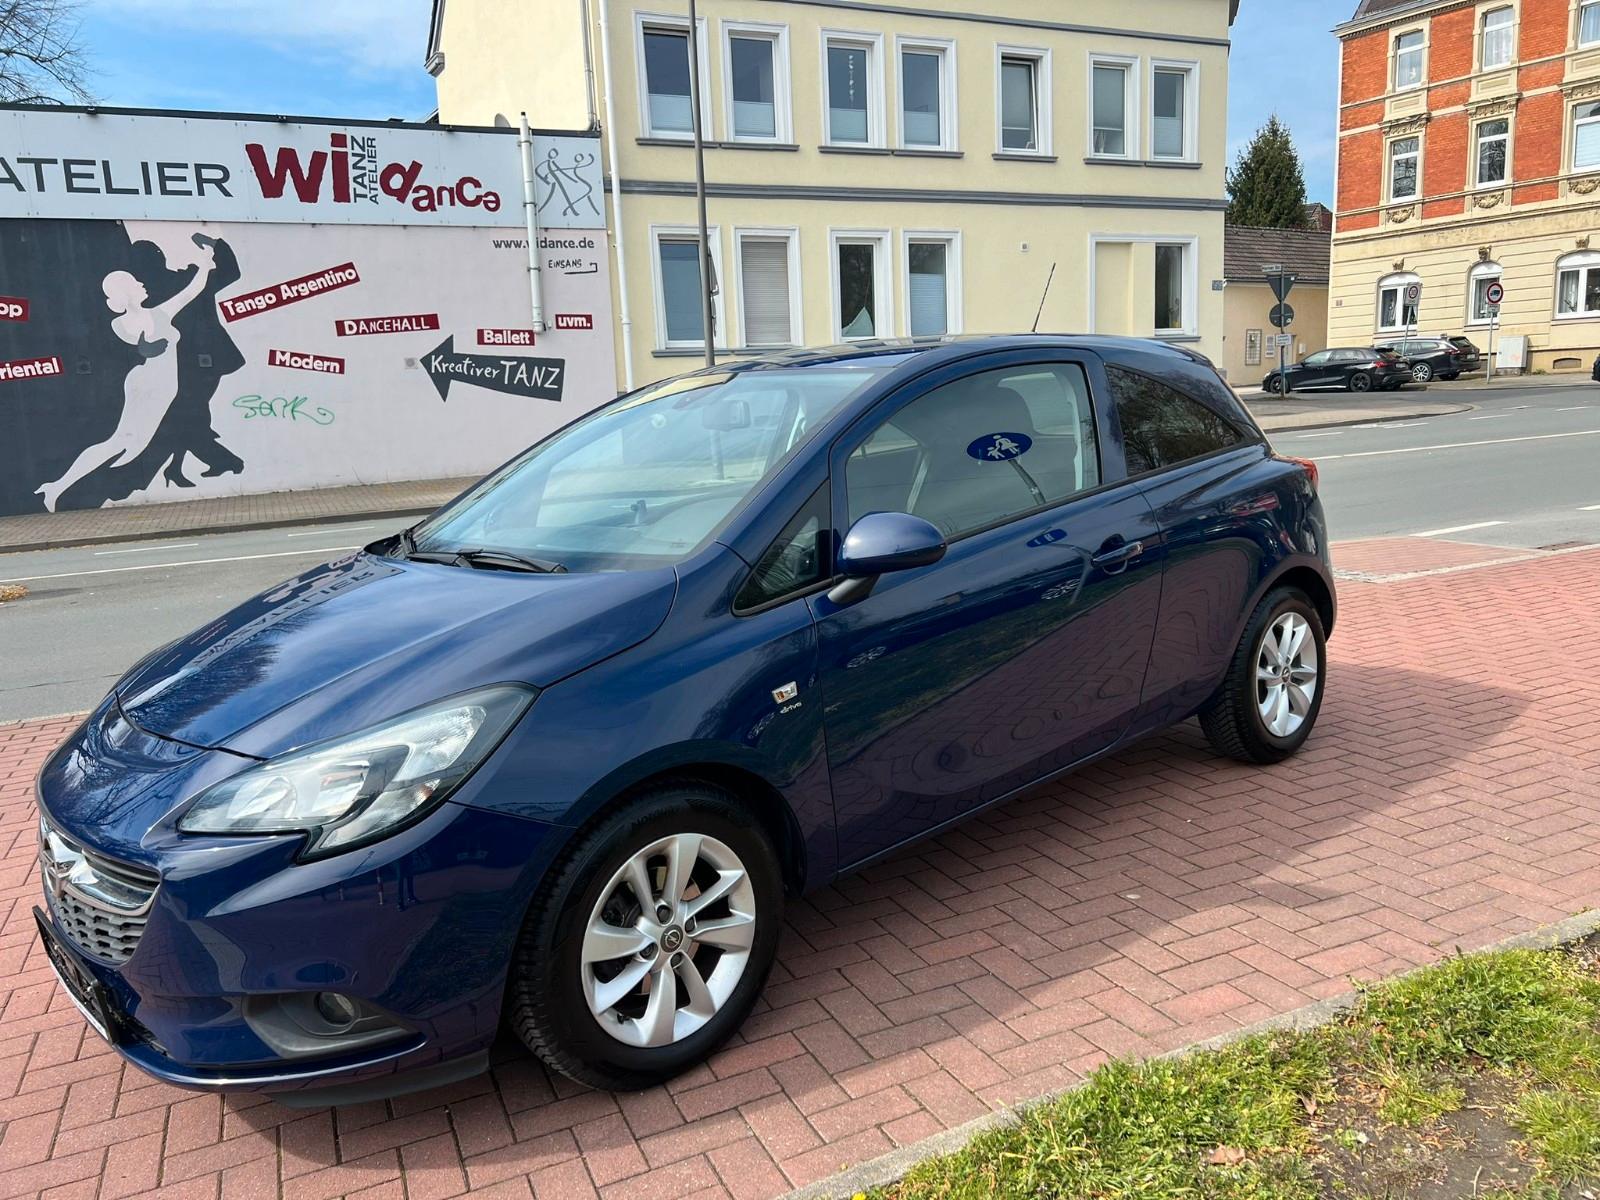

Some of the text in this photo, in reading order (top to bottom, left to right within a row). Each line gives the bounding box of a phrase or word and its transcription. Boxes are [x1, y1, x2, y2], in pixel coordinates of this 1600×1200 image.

[0, 157, 234, 198] ATELIER
[350, 135, 368, 203] TANZ
[365, 136, 380, 205] ATELIER
[492, 237, 595, 249] www.idance.de
[223, 268, 357, 317] Tango Argentino
[343, 316, 431, 336] DANCEHALL
[557, 316, 591, 328] uvm.
[483, 330, 531, 345] Ballett
[275, 350, 340, 374] Modern
[430, 354, 560, 389] Kreativer TANZ
